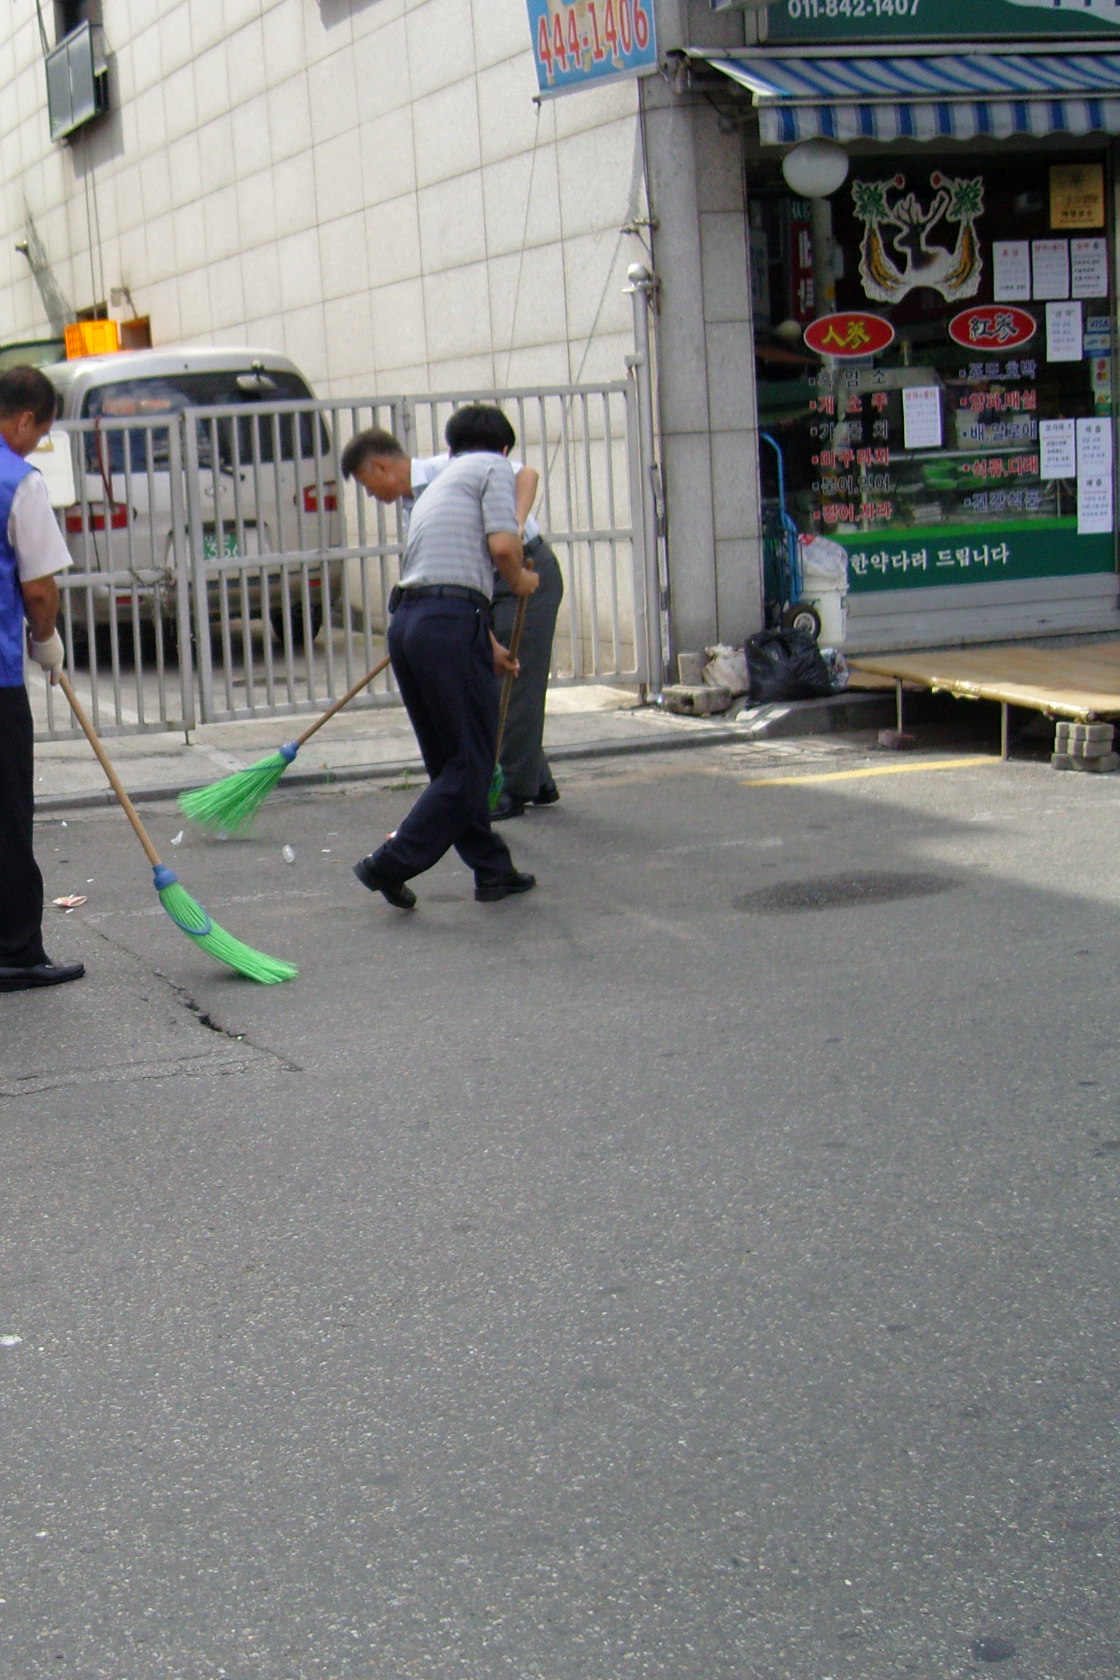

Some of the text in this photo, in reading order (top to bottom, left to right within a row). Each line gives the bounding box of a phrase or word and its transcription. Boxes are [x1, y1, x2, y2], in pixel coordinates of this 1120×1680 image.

[1090, 319, 1109, 328] VISA
[818, 392, 888, 416] 개소주
[969, 390, 1036, 413] 양파,매실
[820, 447, 889, 470] 미꾸라지
[973, 455, 1039, 479] 석류,다래
[823, 500, 893, 524] 장어,자라
[850, 542, 1009, 575] 한약다려 드립니다
